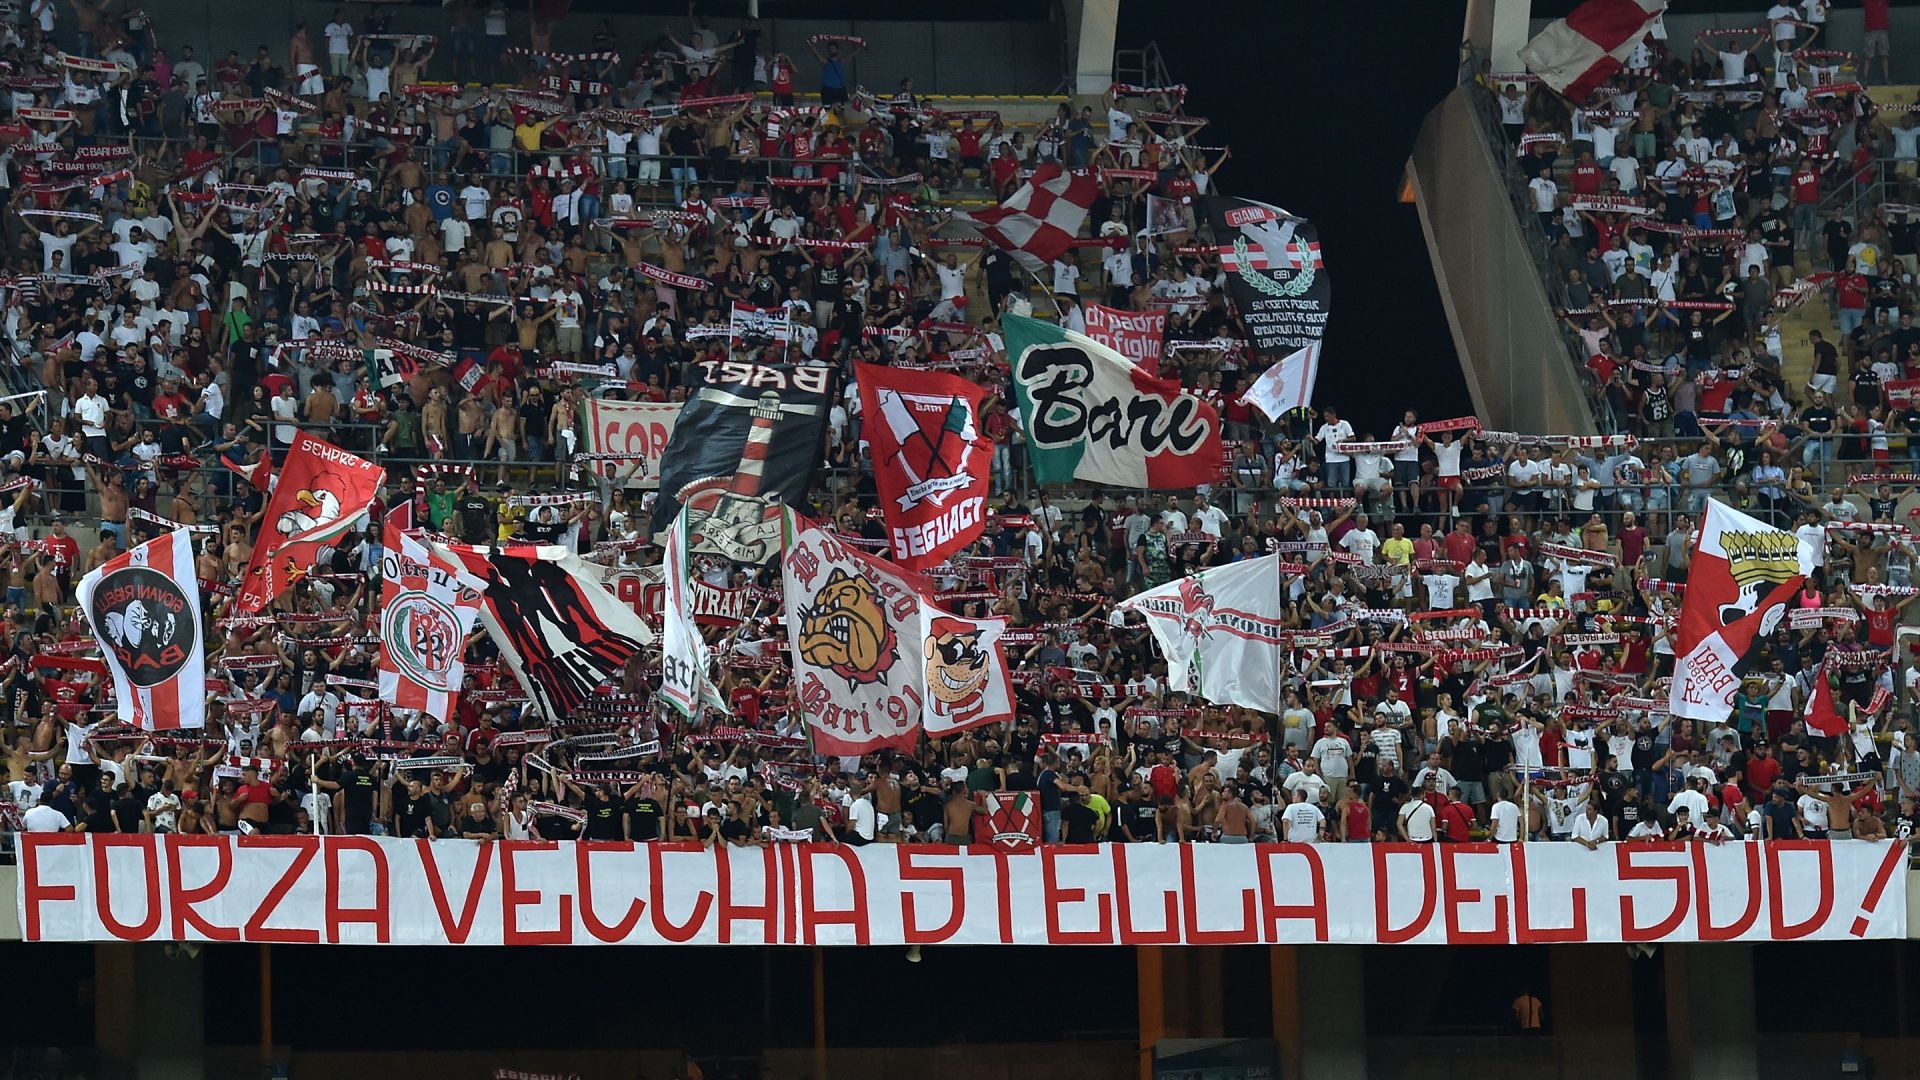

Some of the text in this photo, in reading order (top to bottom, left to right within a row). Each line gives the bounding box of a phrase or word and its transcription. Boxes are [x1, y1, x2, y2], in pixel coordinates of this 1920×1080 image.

[24, 143, 44, 153] BARI
[78, 145, 130, 158] FC BARI 1908
[53, 161, 64, 171] FC
[66, 162, 84, 171] BARI
[1797, 174, 1815, 185] BARI
[1231, 207, 1265, 224] GIANNI
[805, 239, 860, 249] ULTRAS
[644, 266, 697, 287] FORZA BARI
[1273, 269, 1291, 279] 1991
[1085, 308, 1165, 337] di padre
[1115, 331, 1160, 362] figlio
[1016, 342, 1210, 457] Bari
[915, 405, 943, 413] BARI
[301, 439, 373, 470] SEMPRE A
[893, 496, 984, 560] SEGUACI
[383, 553, 429, 579] Oltre
[433, 571, 449, 588] il
[1280, 563, 1302, 572] BARI
[1015, 633, 1034, 641] NORD
[1425, 629, 1474, 641] SEGUACI
[414, 627, 446, 662] 22
[664, 653, 697, 698] ari
[1399, 677, 1408, 691] 7
[582, 702, 648, 714] FOMENTO
[801, 672, 923, 734] Bari '91
[1563, 705, 1576, 715] FC
[1199, 730, 1250, 741] ULTRAS
[573, 771, 641, 781] FOMENTO
[22, 831, 391, 943] FORZA
[415, 838, 870, 945] VECCHIA
[898, 841, 1329, 945] STELLA
[1372, 840, 1588, 944] DEL
